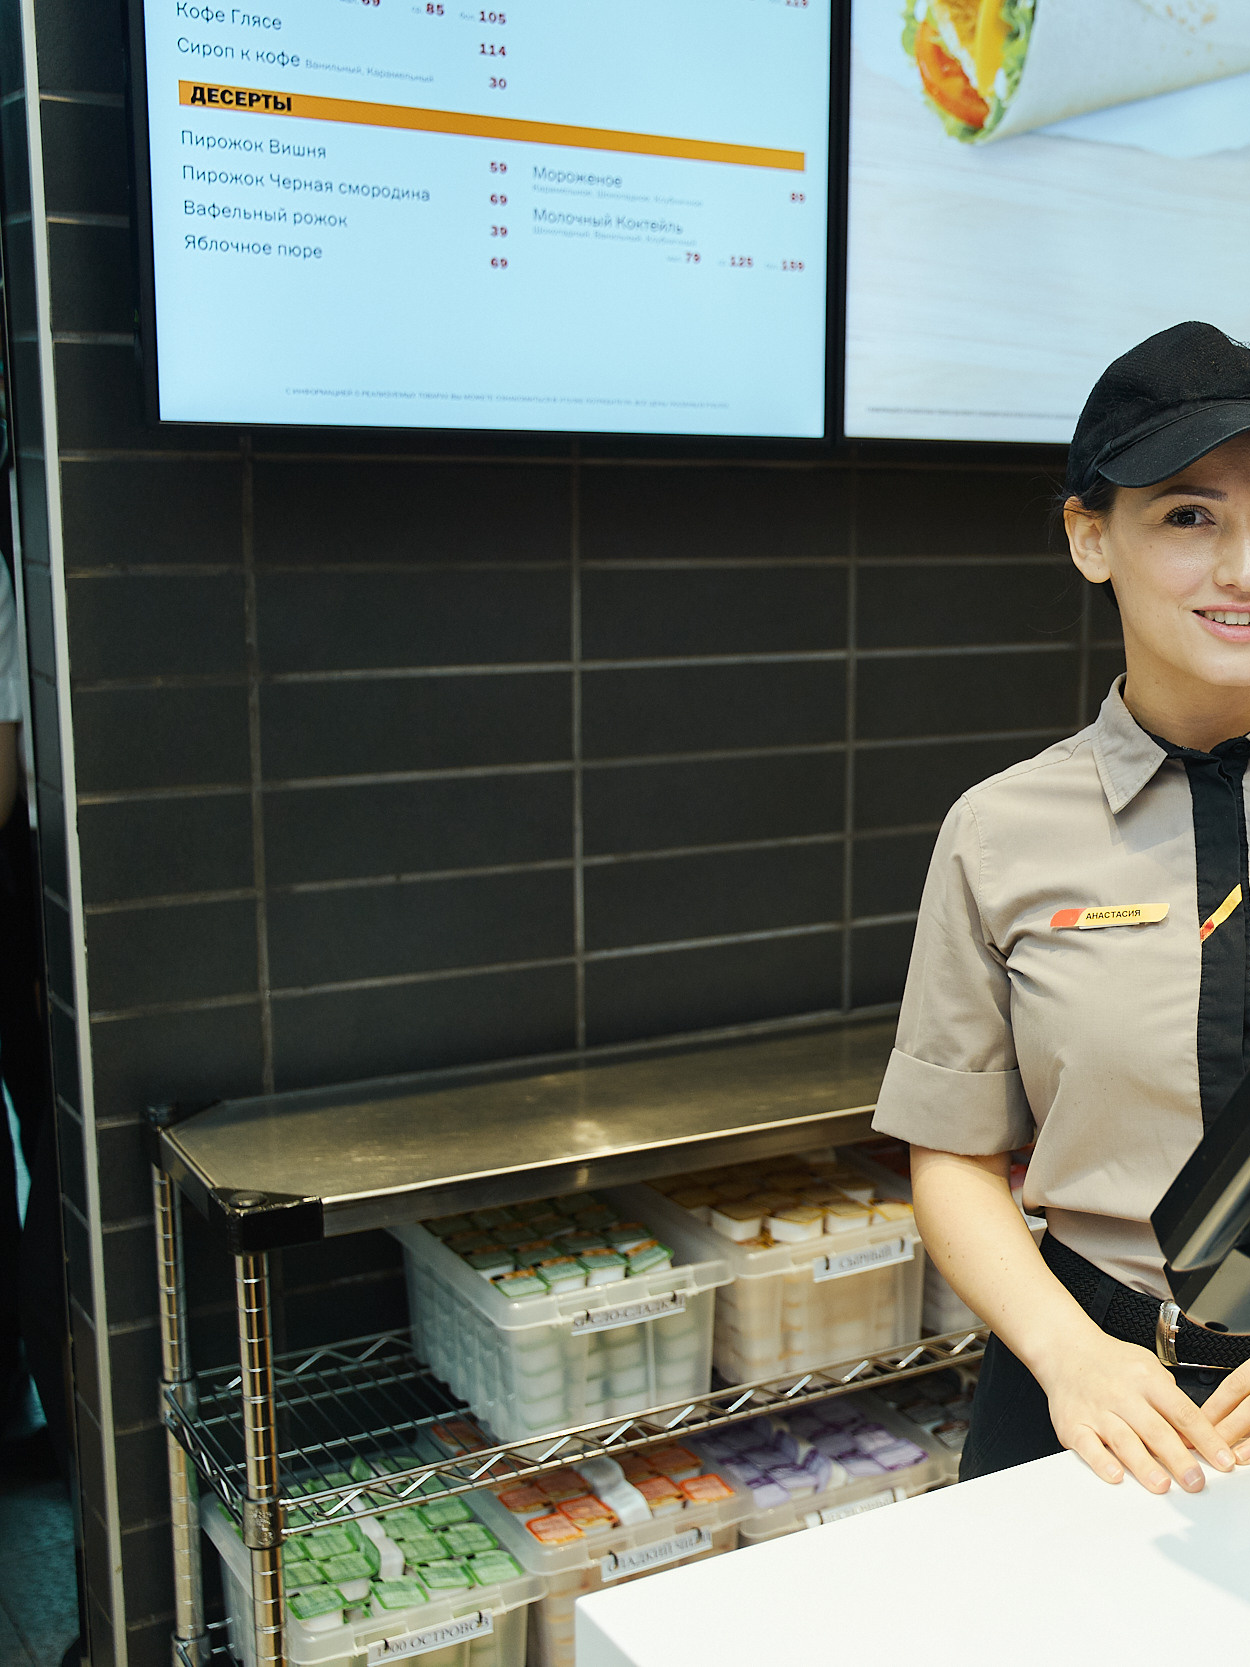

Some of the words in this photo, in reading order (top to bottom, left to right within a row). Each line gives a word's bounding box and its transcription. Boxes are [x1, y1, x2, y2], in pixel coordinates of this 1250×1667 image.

[176, 1, 225, 22] Кофе
[231, 9, 282, 30] Глясе
[426, 3, 444, 16] 85
[479, 11, 506, 24] 105
[177, 37, 234, 58] Сироп
[241, 49, 250, 61] к
[256, 50, 300, 67] кофе
[480, 43, 507, 57] 114
[489, 77, 507, 89] 30
[190, 86, 292, 112] ДЕСЕРТЫ
[181, 130, 263, 153] Пирожок
[269, 140, 326, 158] Вишня
[490, 162, 507, 173] 59
[182, 166, 265, 188] Пирожок
[269, 174, 334, 194] Черная
[338, 183, 431, 202] смородина
[533, 166, 623, 189] Мороженое
[490, 194, 507, 206] 69
[184, 201, 287, 223] Вафельный
[293, 211, 348, 228] рожок
[533, 208, 612, 228] Молочный
[616, 215, 684, 234] Коктейль
[490, 225, 507, 237] 39
[184, 235, 273, 255] Яблочное
[277, 244, 323, 260] пюре
[490, 257, 507, 269] 69
[1085, 909, 1141, 920] АНАСТАСИЯ
